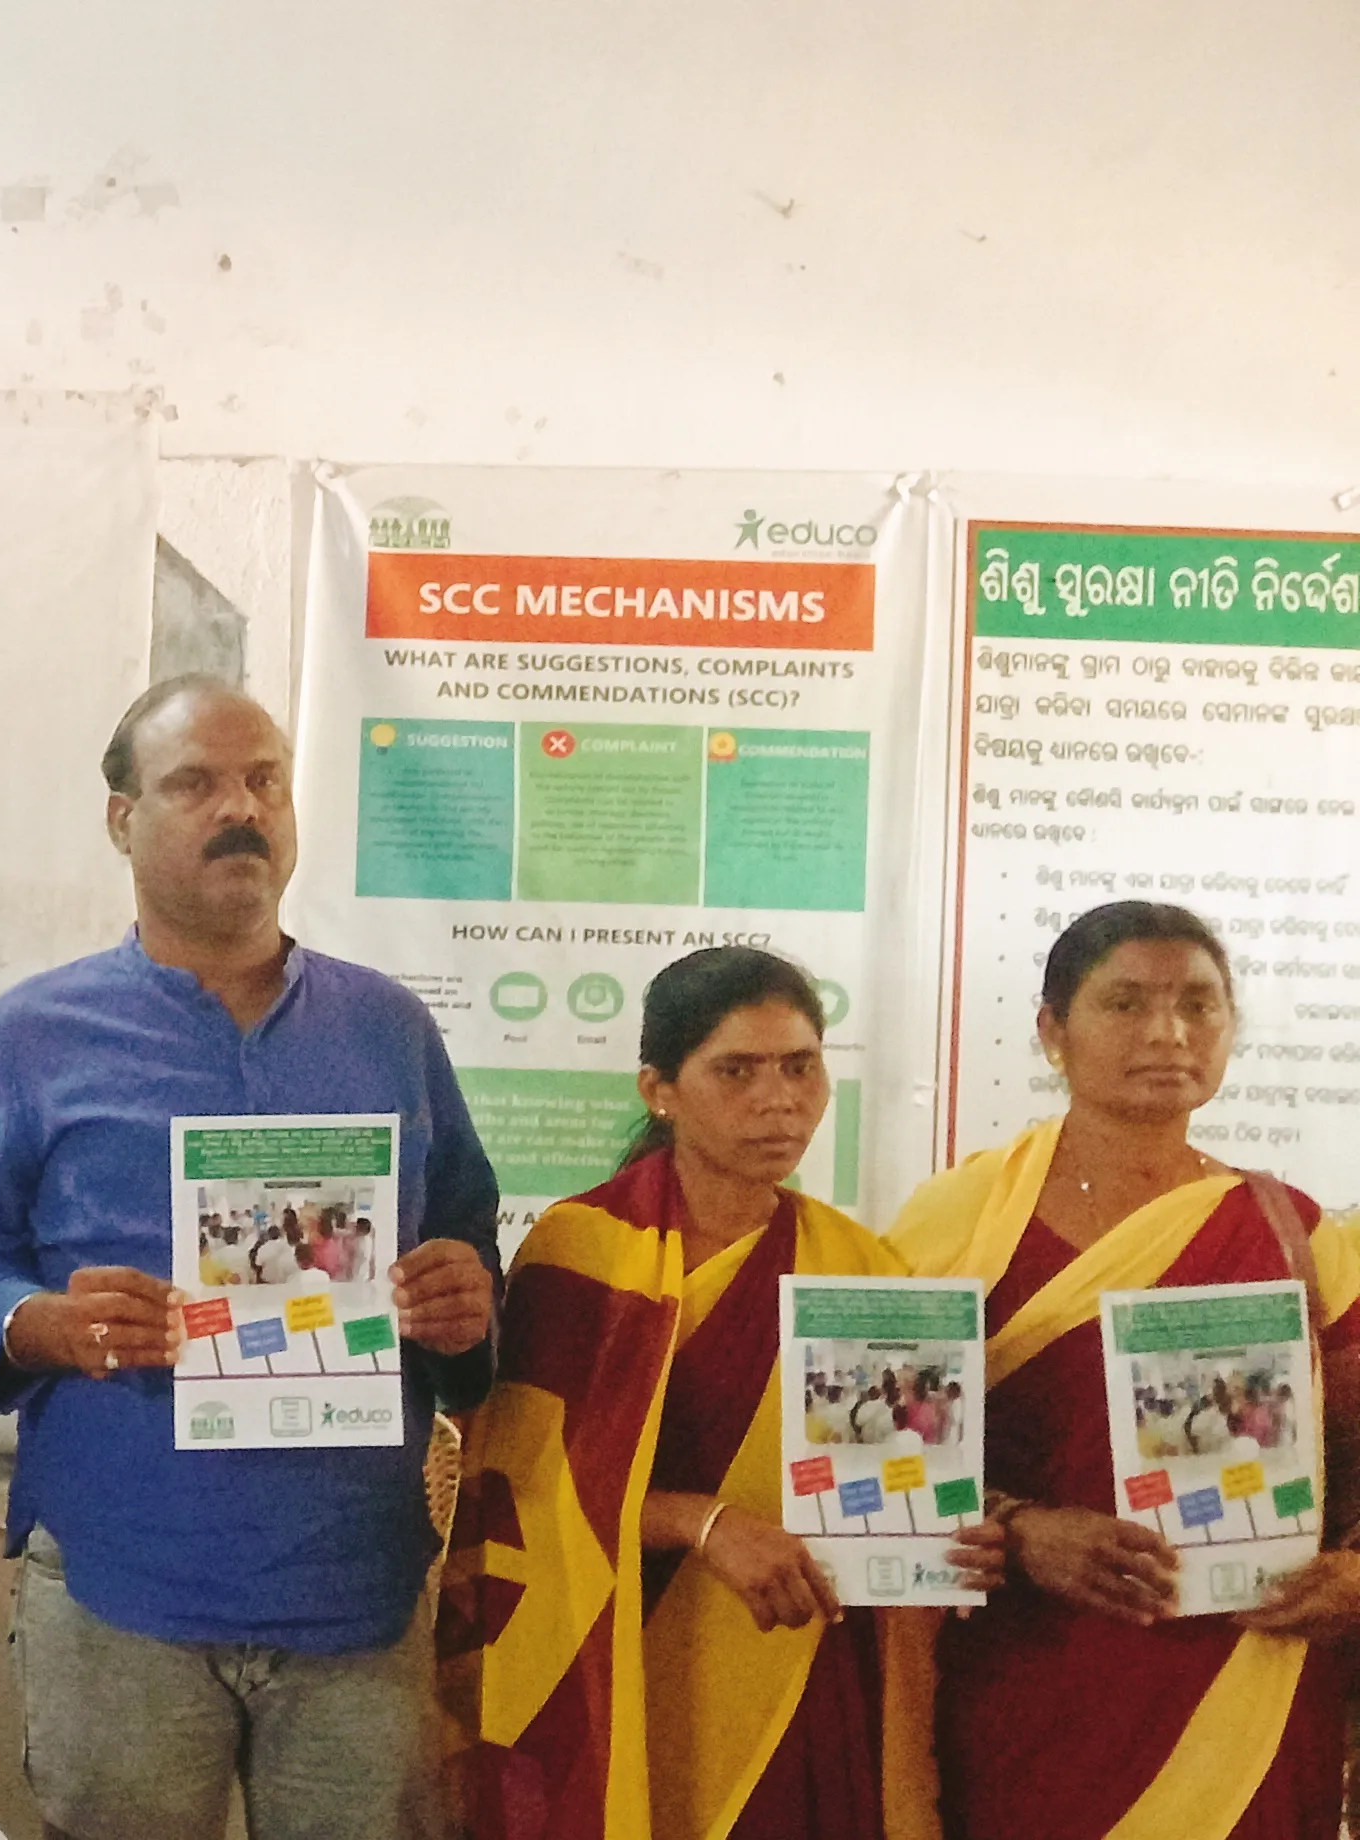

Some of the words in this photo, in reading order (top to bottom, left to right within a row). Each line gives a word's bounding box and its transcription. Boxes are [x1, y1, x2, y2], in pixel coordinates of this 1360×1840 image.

[767, 520, 877, 547] educo
[980, 548, 1046, 615] ଶିଶୁ
[1055, 563, 1155, 617] ସୁରକ୍ଷା
[1169, 556, 1239, 610] ନୀତି
[419, 582, 501, 616] SCC
[516, 585, 826, 624] MECHANISMS
[384, 649, 457, 668] WHAT
[464, 653, 509, 671] ARE
[517, 653, 689, 678] SUGGESTIONS,
[697, 657, 855, 680] COMPLAINTS
[437, 681, 489, 700] AND
[497, 683, 720, 705] COMMENDATIONS
[728, 688, 801, 709] (SCC)?
[407, 733, 508, 749] SUGGESTION
[581, 737, 676, 753] COMPLAINT
[452, 924, 510, 941] HOW
[515, 926, 562, 943] CAN
[570, 927, 576, 943] I
[583, 928, 677, 946] PRESENT
[682, 931, 715, 947] AN
